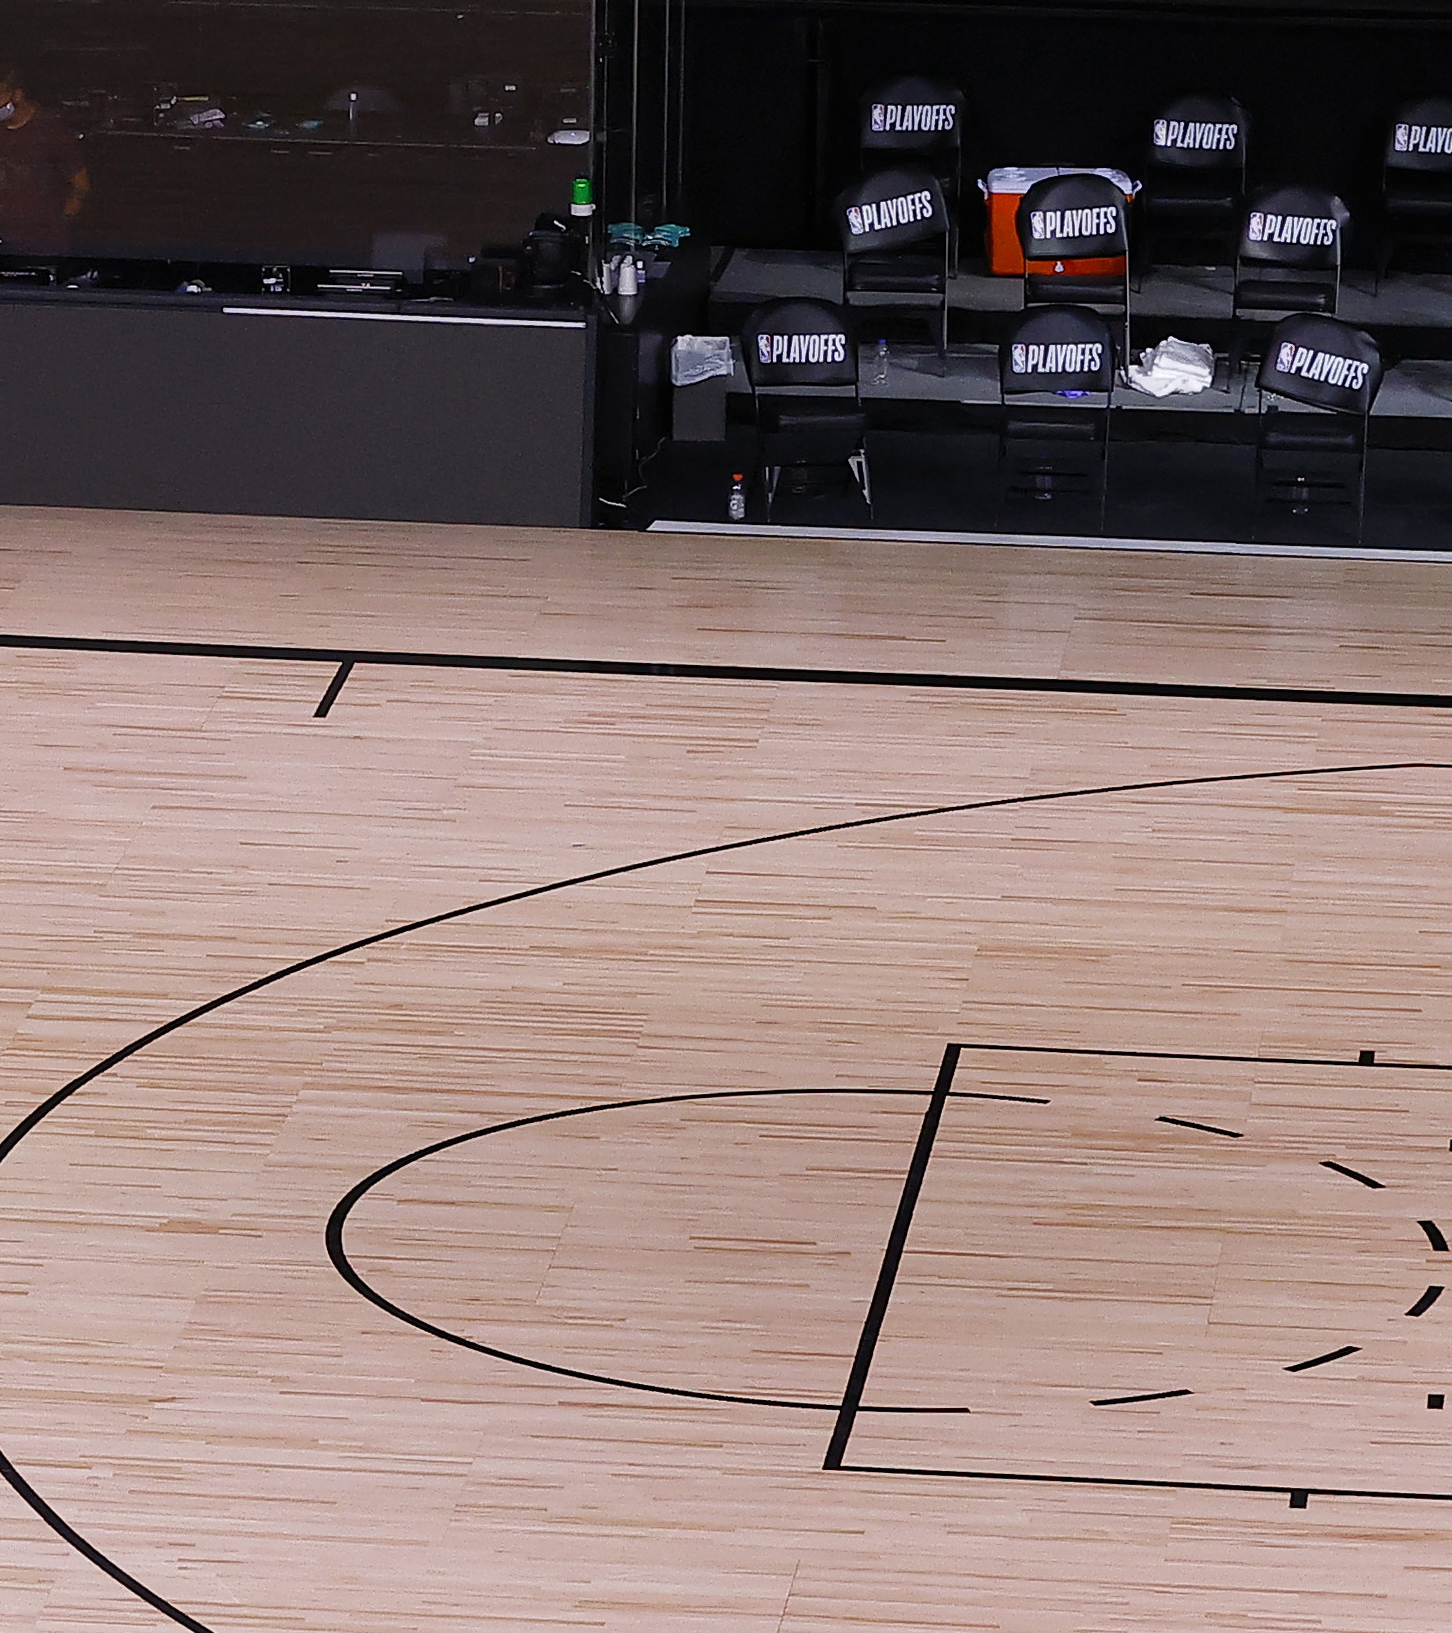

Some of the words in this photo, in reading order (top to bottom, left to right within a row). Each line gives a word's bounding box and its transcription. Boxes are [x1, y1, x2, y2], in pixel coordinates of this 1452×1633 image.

[885, 104, 956, 131] PLAYOFFS
[1167, 121, 1238, 150] PLAYOFFS
[861, 190, 933, 233] PLAYOFFS
[1045, 206, 1117, 239] PLAYOFFS
[1262, 215, 1337, 246] PLAYOFFS
[772, 334, 846, 363] PLAYOFFS
[1027, 343, 1102, 374] PLAYOFFS
[1290, 347, 1370, 391] PLAYOFFS
